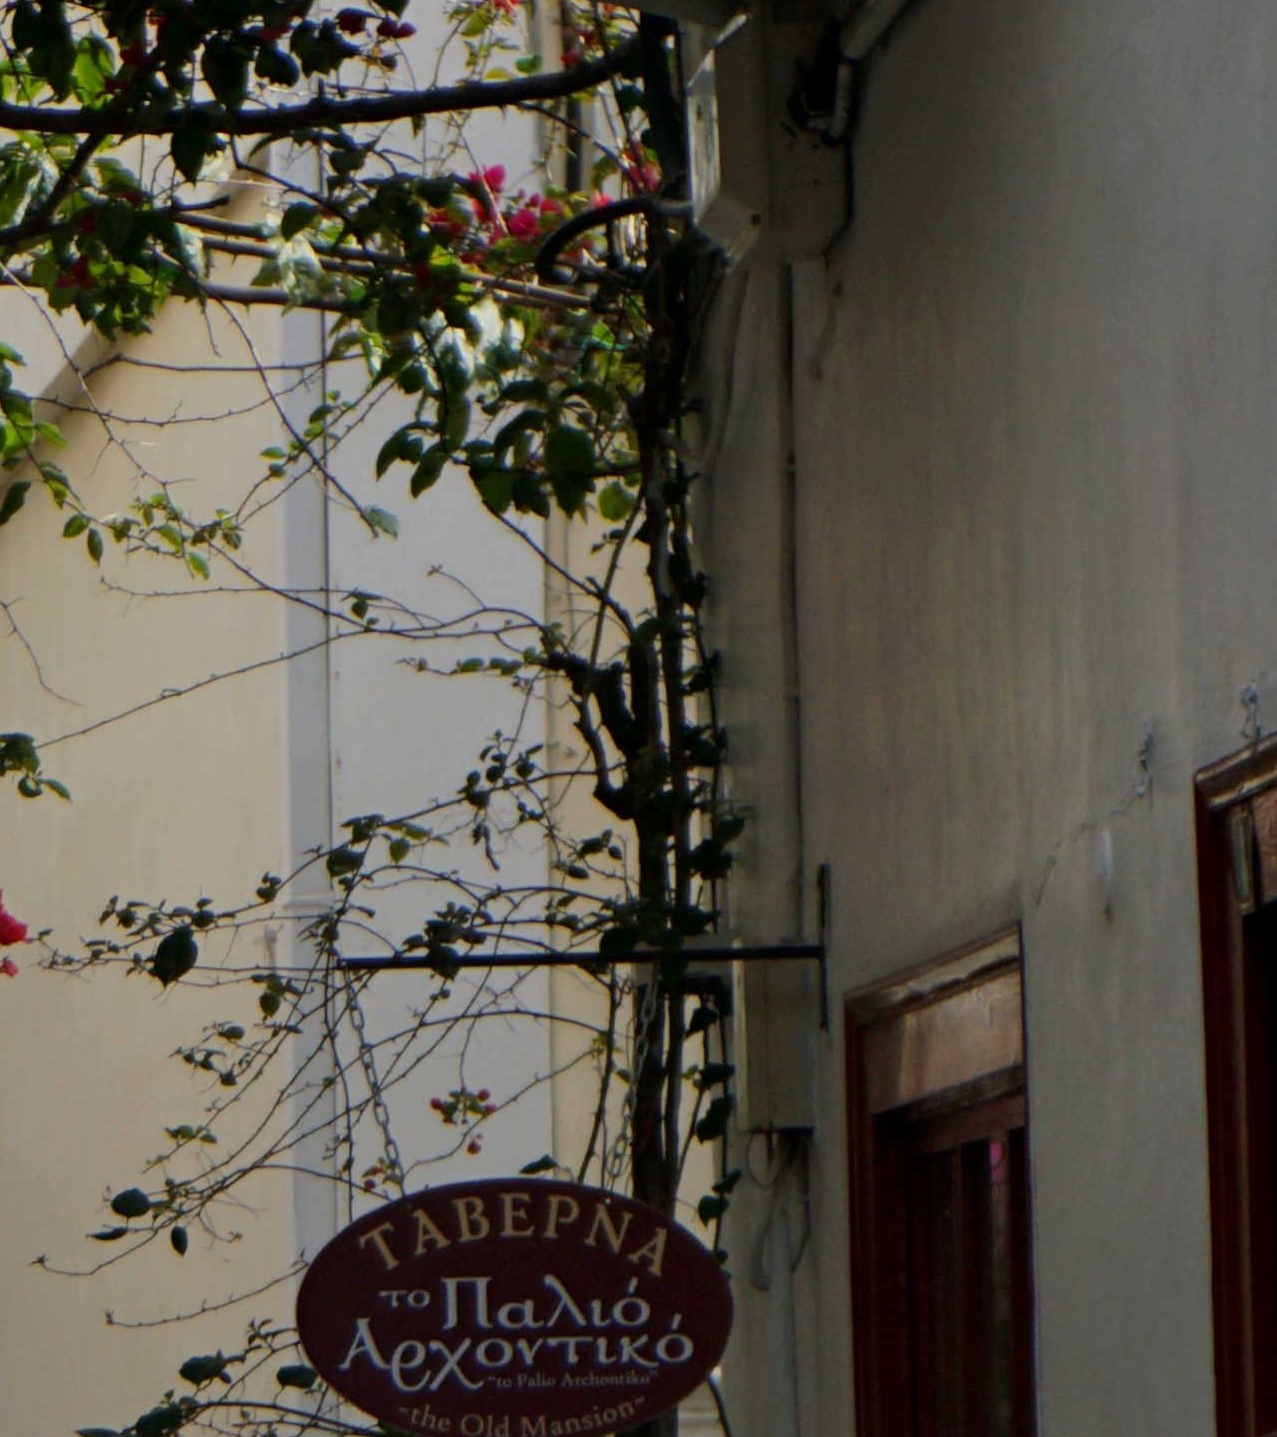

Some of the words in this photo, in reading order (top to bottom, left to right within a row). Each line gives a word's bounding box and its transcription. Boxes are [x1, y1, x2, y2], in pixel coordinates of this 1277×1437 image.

[358, 1191, 669, 1278] ΤΑΒΕΡΝΑ
[440, 1273, 651, 1330] Παλιό
[337, 1312, 695, 1393] Αρχοντικό
[517, 1371, 556, 1388] Palio
